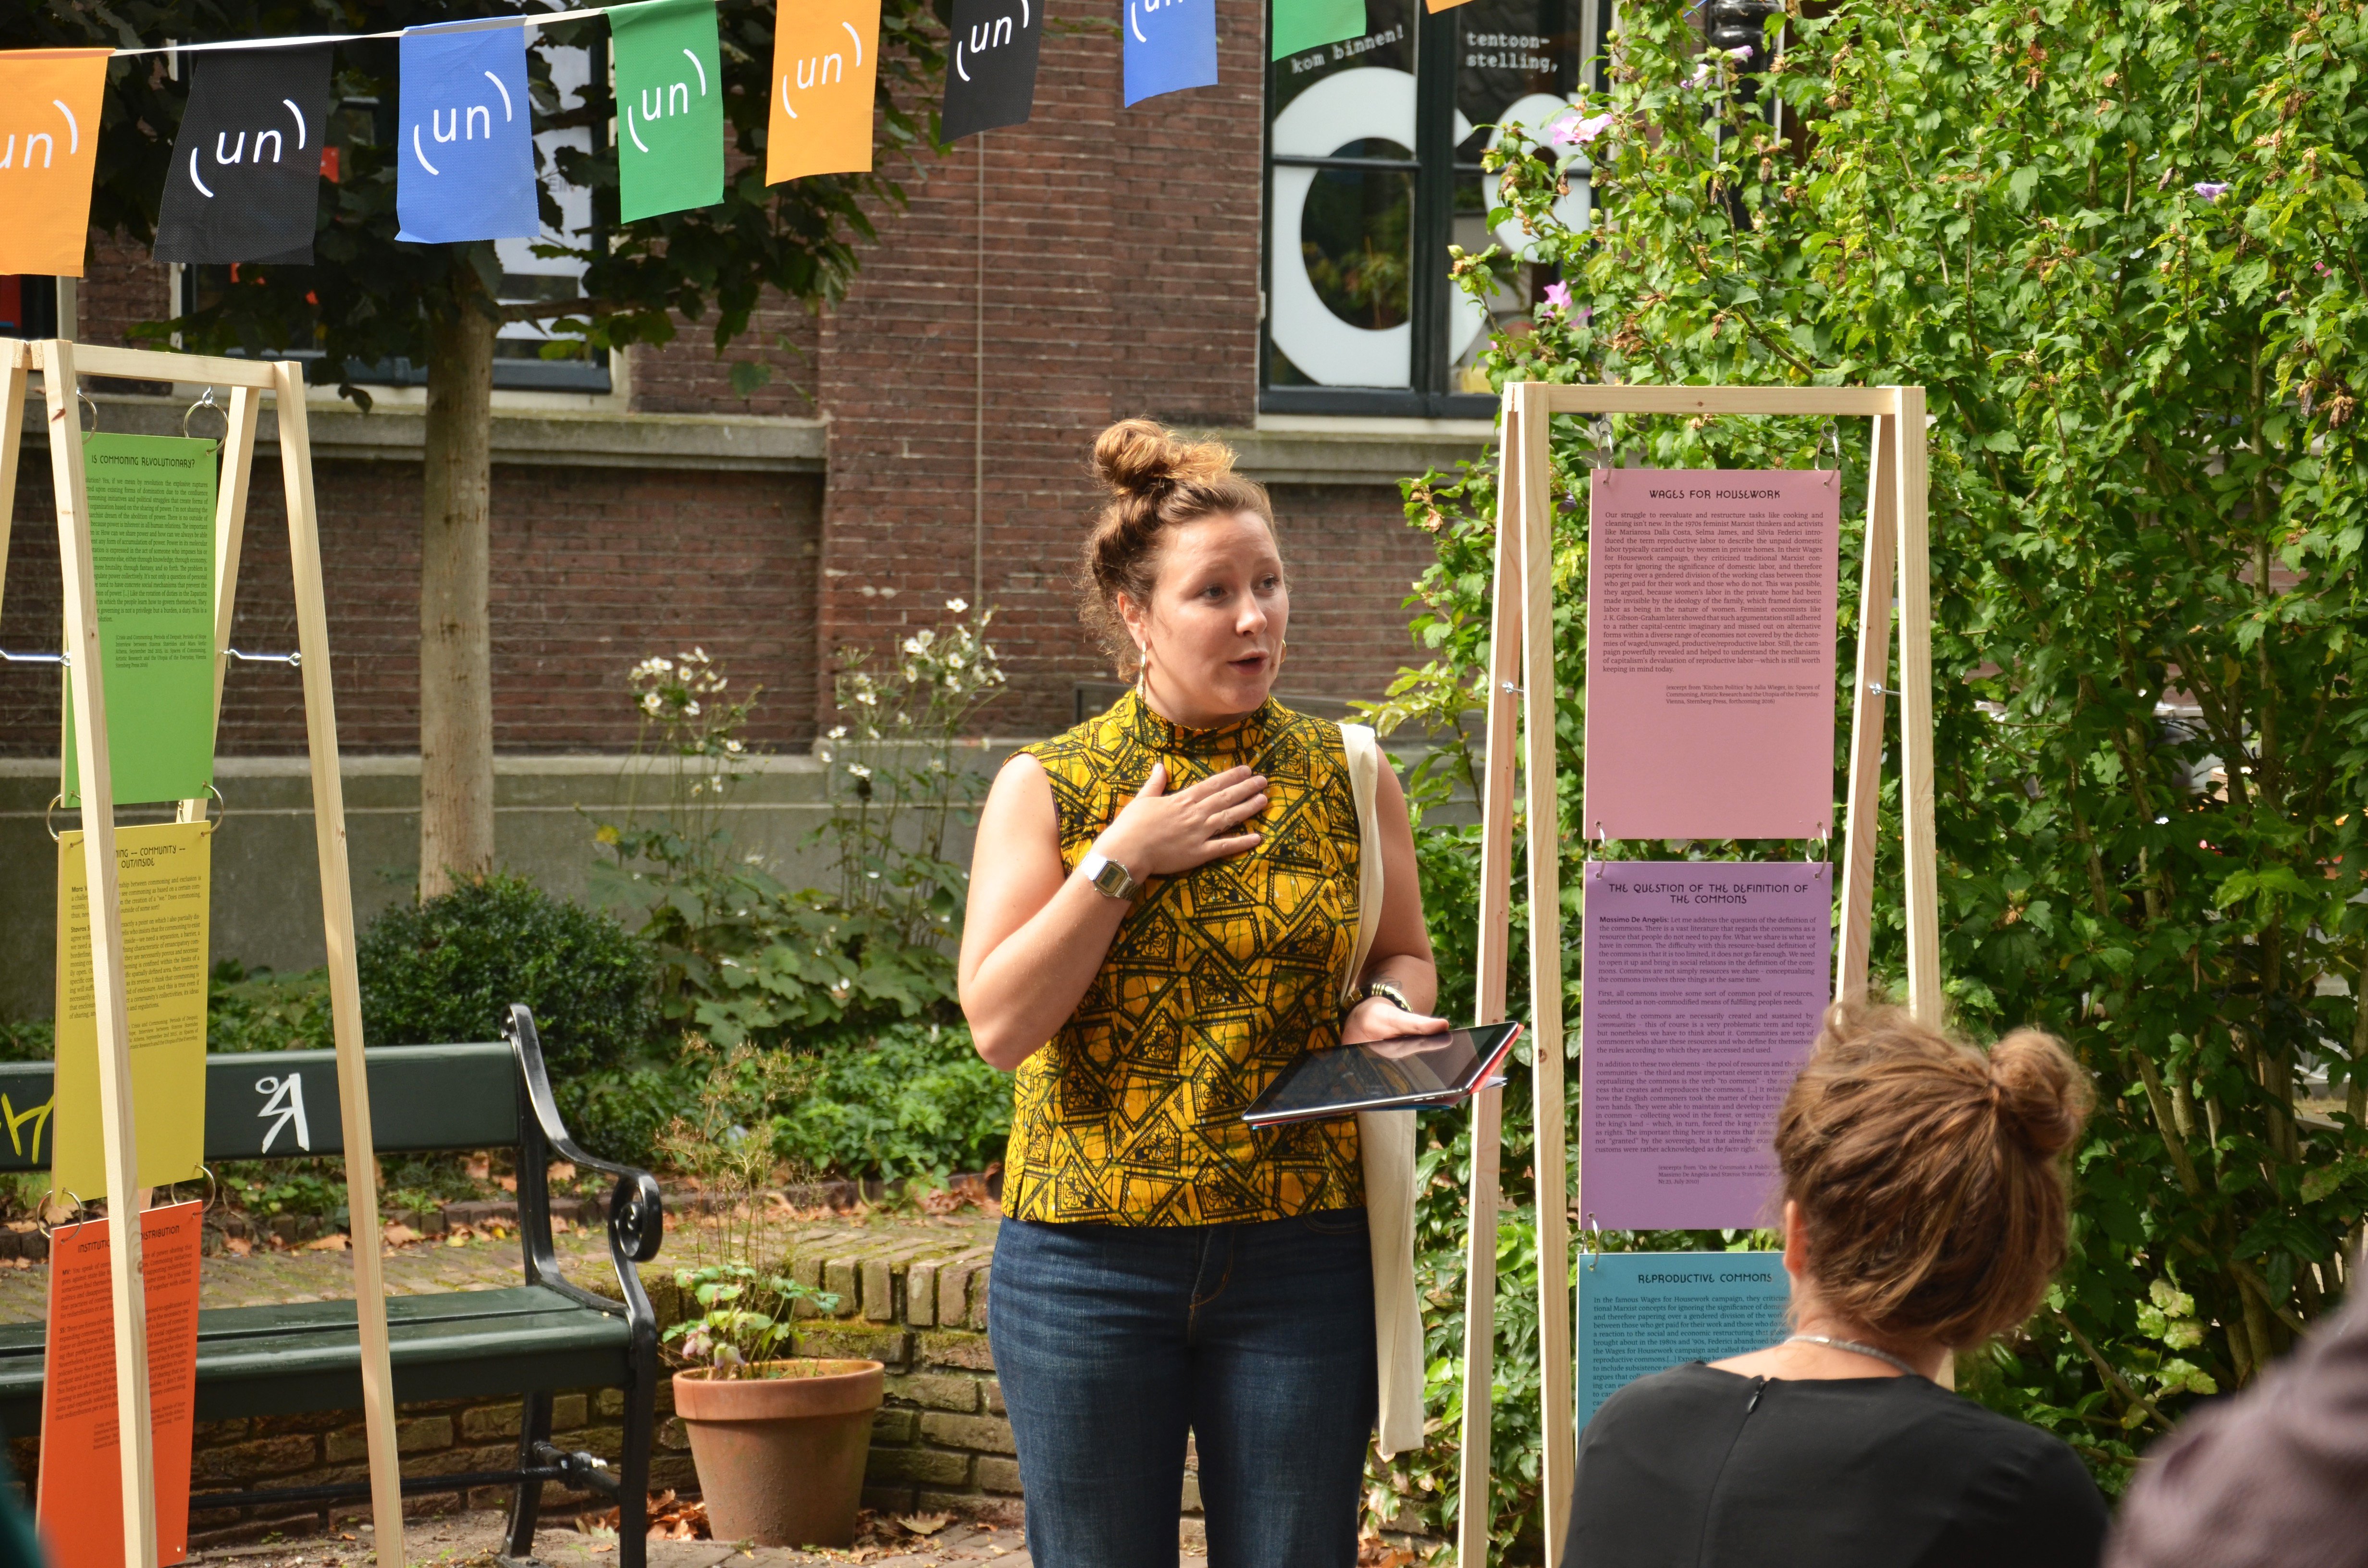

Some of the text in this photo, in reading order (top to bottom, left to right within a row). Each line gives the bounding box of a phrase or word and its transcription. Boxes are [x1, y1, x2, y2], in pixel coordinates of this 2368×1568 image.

[957, 0, 1029, 82] (un)
[1466, 31, 1551, 49] tentoon-
[1291, 24, 1404, 74] kom binnen!
[1466, 52, 1558, 73] stelling,
[783, 22, 862, 119] (un)
[628, 49, 706, 153] (un)
[413, 71, 512, 175] (un)
[190, 99, 306, 197] (un)
[91, 454, 195, 468] IS COMMONING REVOLUTIONARY?
[1649, 490, 1780, 499] WAGES FOR HOUSEWORK
[1620, 511, 1646, 519] struggle
[1605, 520, 1632, 528] cleaning
[1657, 537, 1697, 545] reproductive
[140, 845, 176, 856] COMMUNITY
[121, 858, 155, 869] OUT/INSIDE
[1608, 883, 1808, 894] THE QUESTION OF THE DEFINITION OF
[1670, 894, 1747, 904] THE COMMONS
[1642, 916, 1669, 924] Angelis:
[1735, 924, 1758, 933] regards
[1638, 1273, 1772, 1284] REPRODUCTIVE COMMONS
[1712, 1295, 1744, 1303] campaign,
[1746, 1295, 1761, 1303] they
[1638, 1304, 1666, 1312] concepts
[1678, 1304, 1704, 1312] ignoring
[1717, 1303, 1754, 1311] significance
